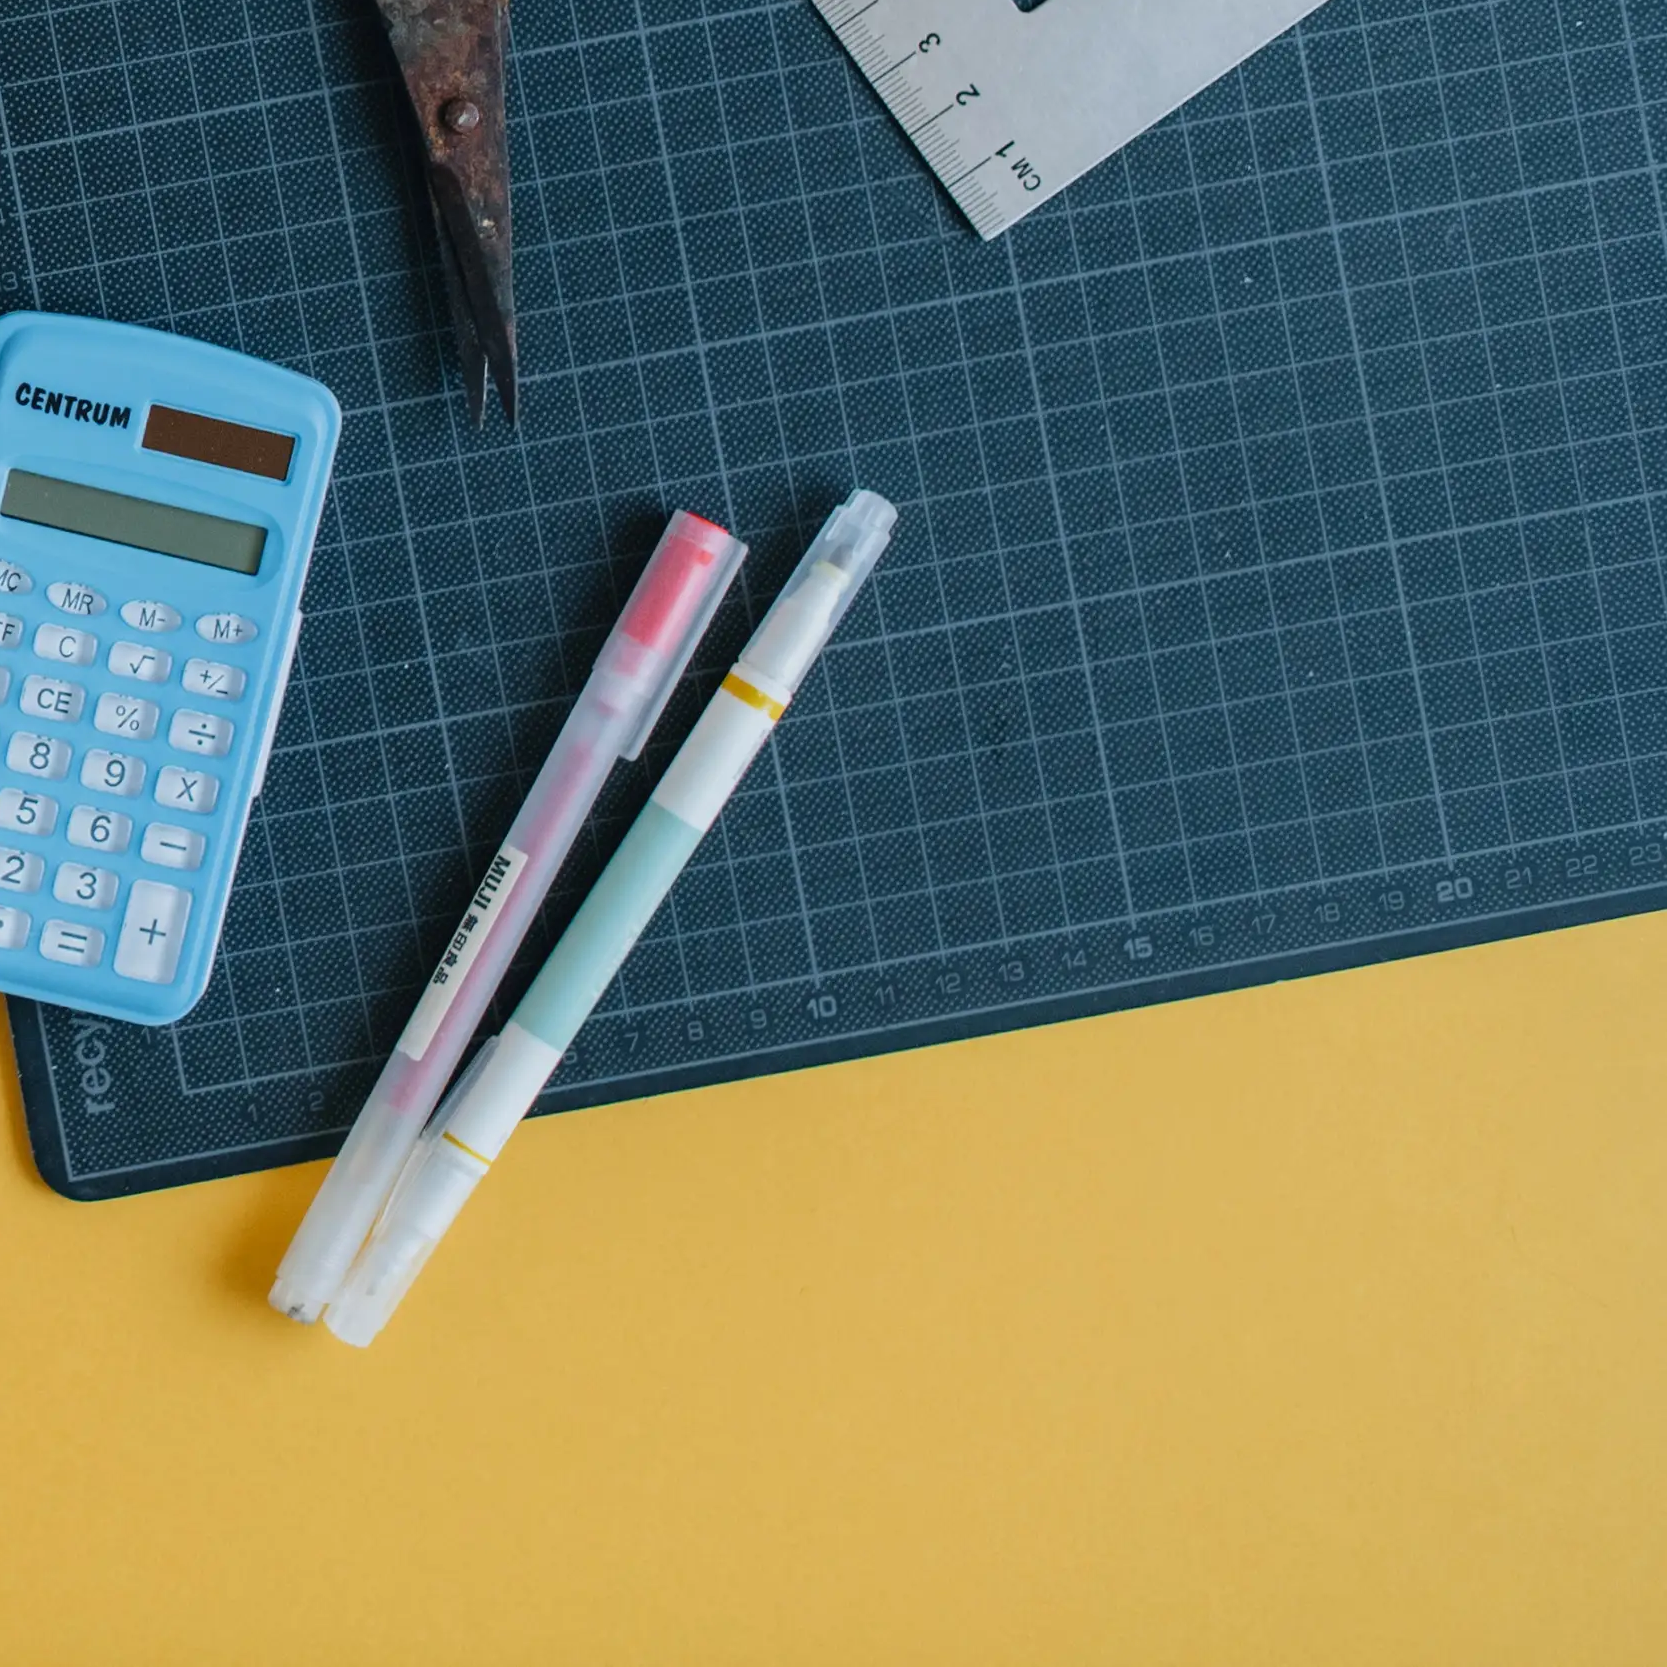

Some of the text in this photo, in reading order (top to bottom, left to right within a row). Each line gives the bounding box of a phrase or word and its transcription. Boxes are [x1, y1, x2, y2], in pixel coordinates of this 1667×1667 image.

[918, 32, 941, 54] 3
[955, 83, 980, 107] 2
[994, 139, 1015, 160] 1
[1010, 160, 1042, 191] CM
[15, 382, 132, 429] CENTRUM
[62, 589, 93, 614] MR
[139, 608, 166, 629] M-
[214, 618, 243, 639] M+
[59, 636, 77, 658] C
[37, 688, 72, 714] CE
[29, 742, 51, 769] 8
[104, 759, 125, 787] 9
[16, 797, 39, 825] 5
[90, 814, 111, 843] 6
[1, 855, 25, 883] 2
[76, 872, 98, 900] 3
[473, 854, 511, 910] MUJI
[433, 913, 478, 984] 無印良品
[248, 1104, 257, 1122] 1
[308, 1090, 325, 1111] 2
[624, 1031, 639, 1053] 7
[687, 1020, 704, 1041] 8
[750, 1009, 768, 1030] 9
[807, 995, 837, 1019] 10
[874, 985, 897, 1007] 11
[936, 973, 961, 994] 12
[999, 961, 1024, 983] 13
[1063, 949, 1087, 970] 14
[1124, 937, 1153, 960] 15
[1189, 926, 1215, 948] 16
[1252, 915, 1276, 935] 17
[1315, 902, 1340, 923] 18
[1378, 891, 1404, 911] 19
[1436, 877, 1473, 902] 20
[1505, 867, 1532, 890] 21
[1565, 854, 1599, 878] 22
[1629, 843, 1662, 866] 23
